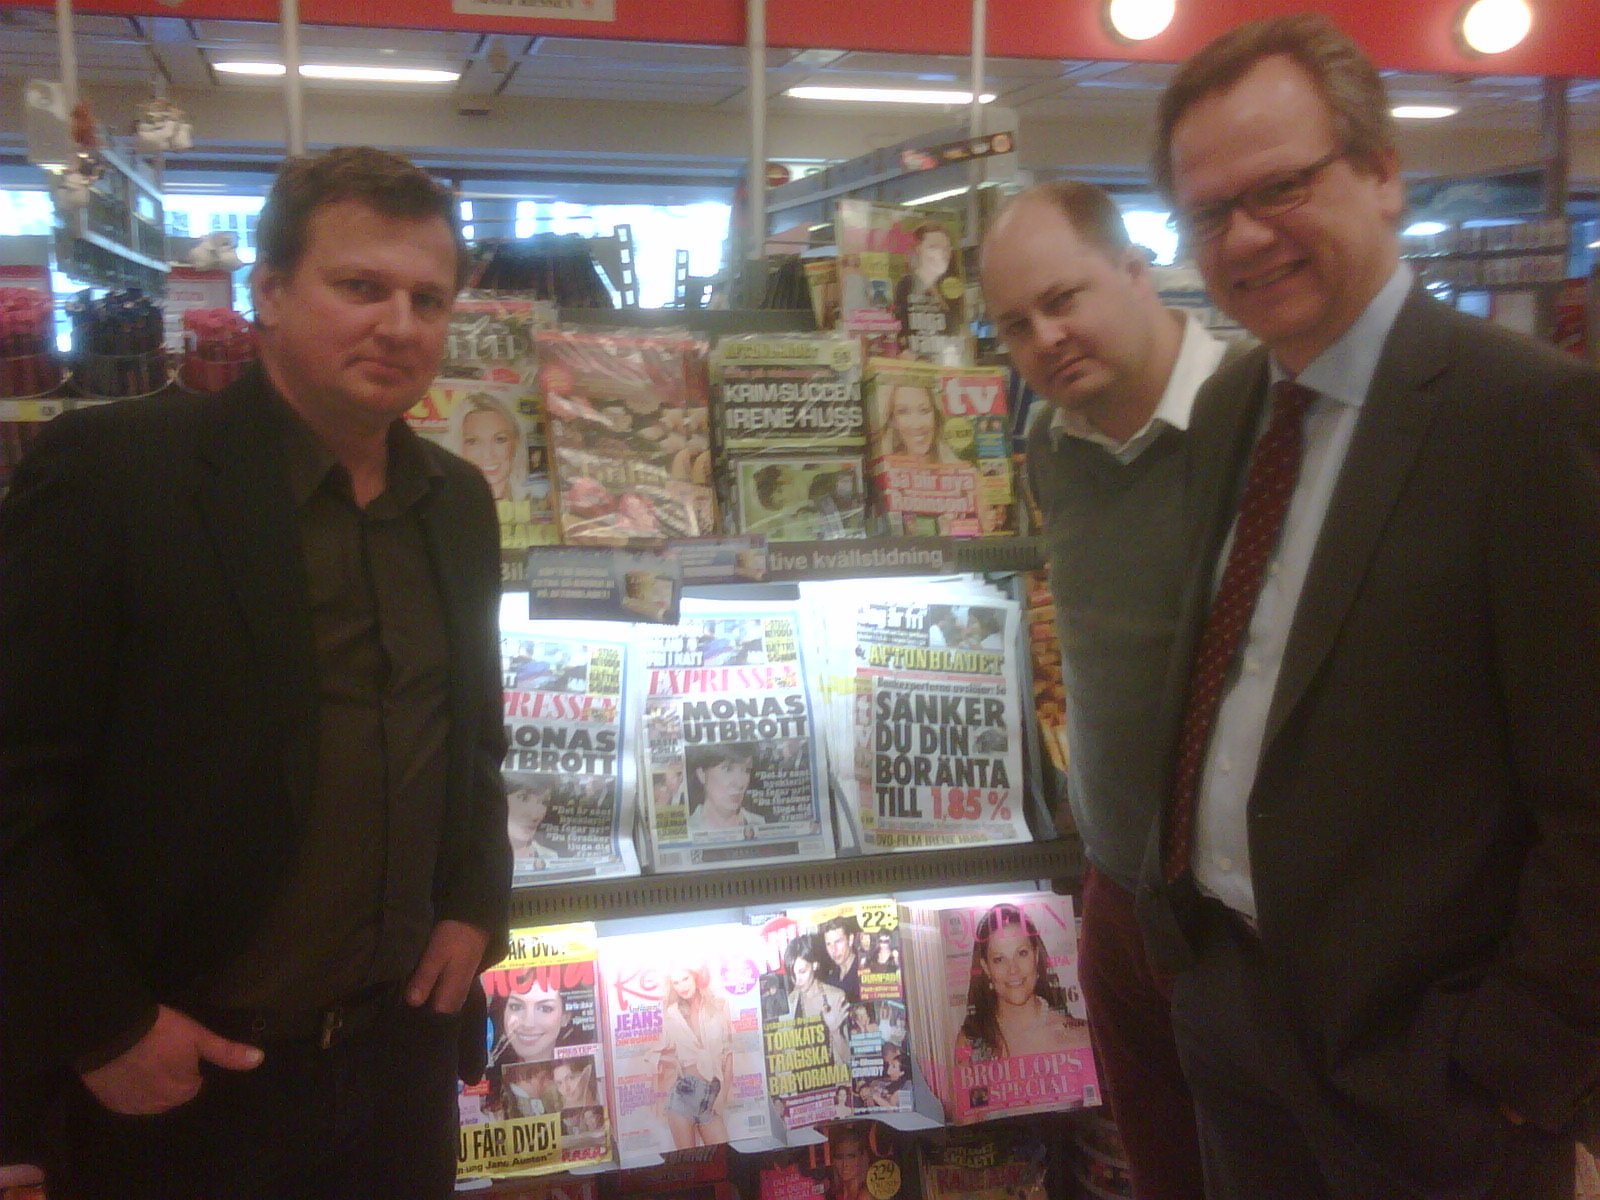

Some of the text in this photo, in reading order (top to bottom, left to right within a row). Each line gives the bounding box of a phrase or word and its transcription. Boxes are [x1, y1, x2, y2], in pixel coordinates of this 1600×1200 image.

[946, 378, 999, 414] tv
[726, 407, 863, 429] IRENE HUSS
[813, 548, 943, 569] kvällstidning
[683, 695, 805, 721] MONAS
[876, 690, 1006, 726] SÄNKER
[683, 716, 807, 743] UTBROTT
[876, 721, 969, 756] DU DIN
[876, 754, 1010, 788] BORÄNTA
[876, 786, 922, 818] TILL
[931, 787, 982, 821] 1,85
[615, 1010, 663, 1032] JEANS
[765, 1024, 825, 1050] TOMKATS
[767, 1046, 829, 1073] TRAGISKA
[961, 1053, 1083, 1089] BRÖLLOPS
[769, 1064, 849, 1096] BABYDRAMA
[990, 1075, 1075, 1100] SPECIAL
[473, 1123, 507, 1160] FÅR
[513, 1120, 557, 1154] DVD!
